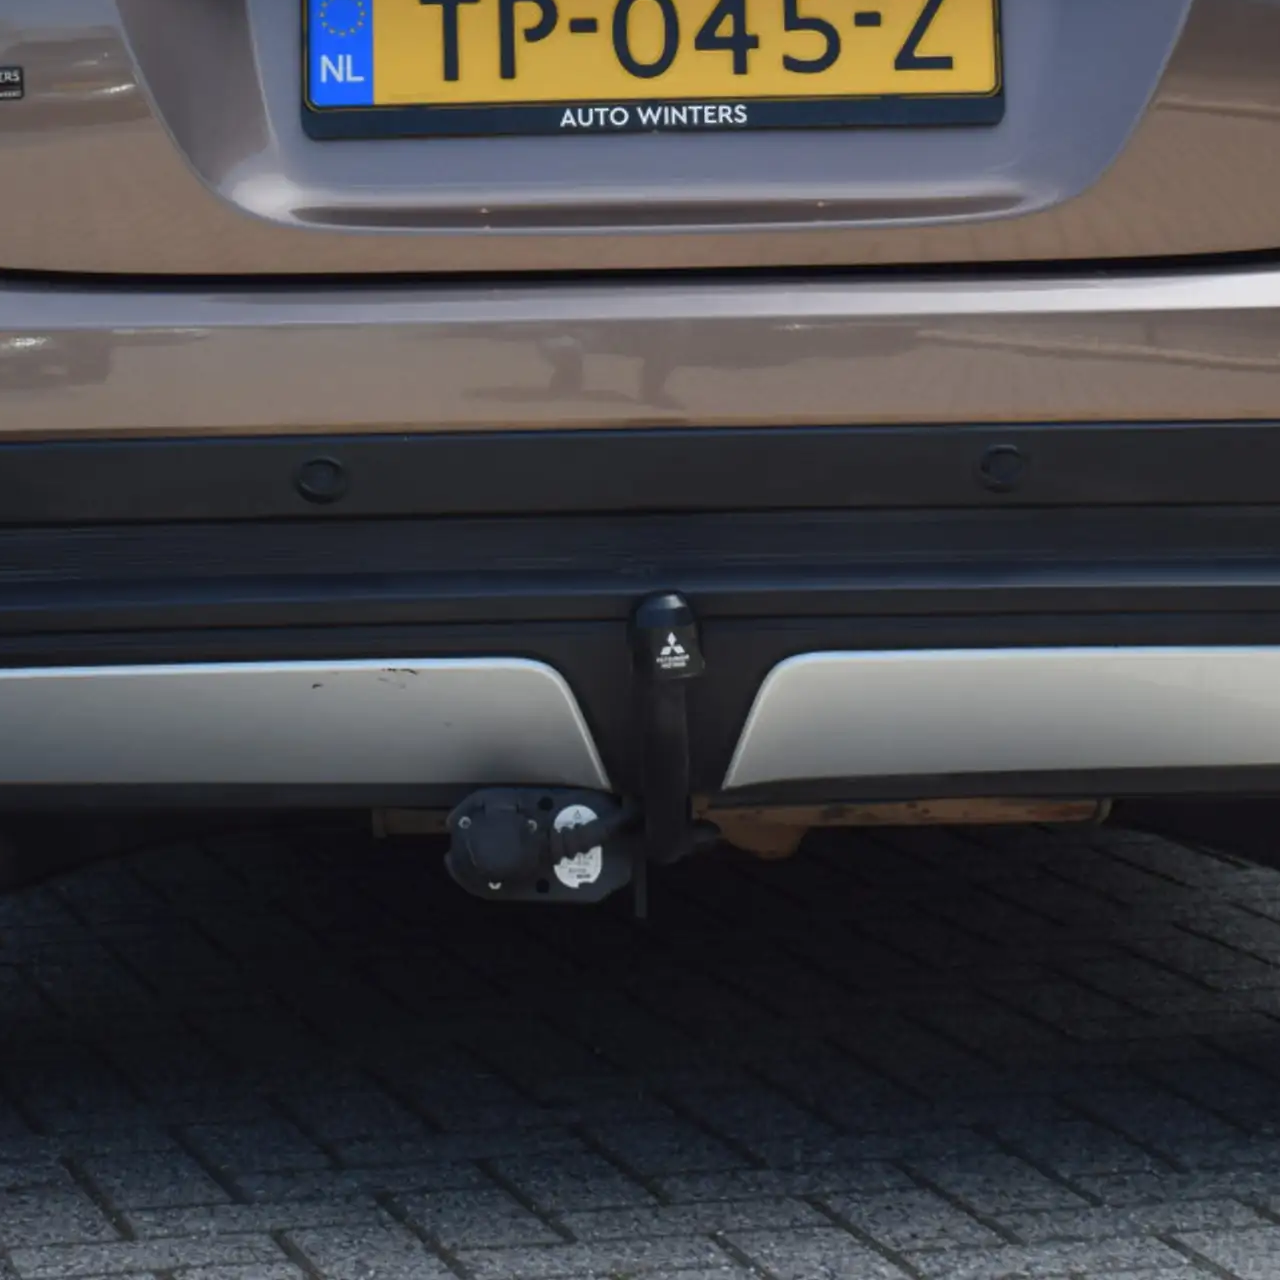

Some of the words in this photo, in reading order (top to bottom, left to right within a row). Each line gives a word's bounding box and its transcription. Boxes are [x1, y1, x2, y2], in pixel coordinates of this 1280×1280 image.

[319, 55, 364, 83] NL
[559, 107, 629, 128] AUTO
[636, 104, 748, 126] WINTERS
